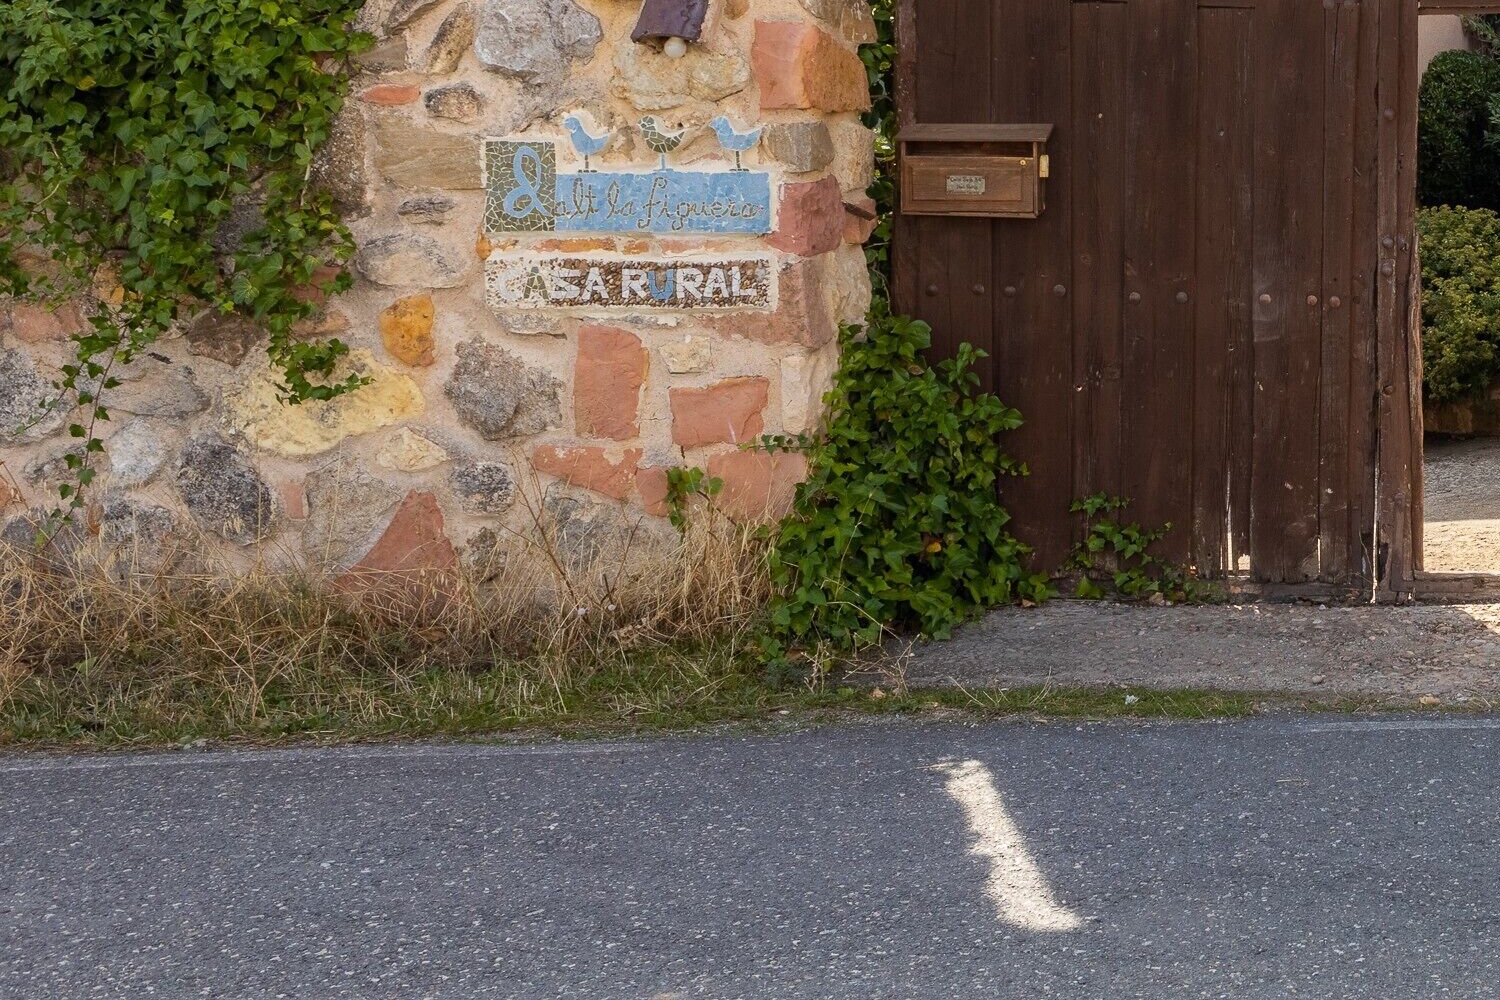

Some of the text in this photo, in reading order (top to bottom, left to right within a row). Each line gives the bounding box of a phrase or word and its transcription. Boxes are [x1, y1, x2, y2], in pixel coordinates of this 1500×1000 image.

[606, 180, 637, 219] la
[496, 266, 758, 301] CASA RURAL
